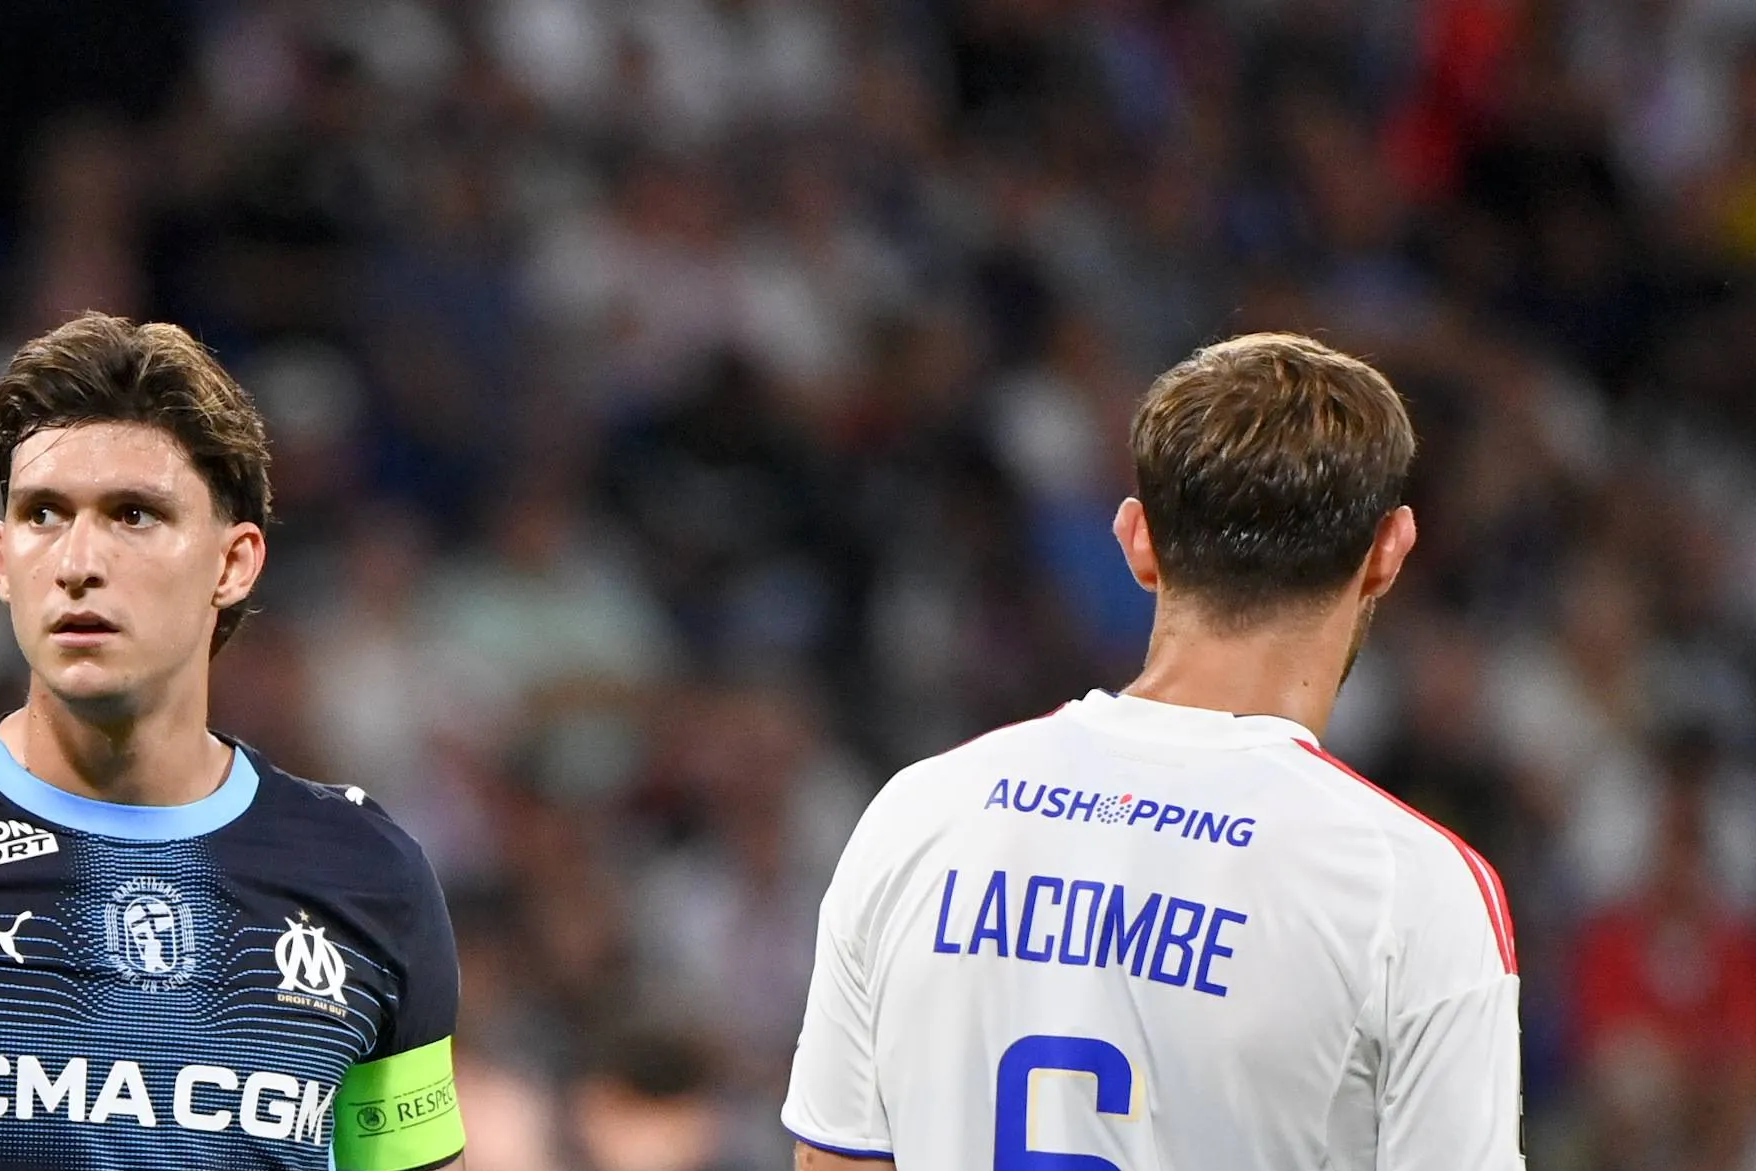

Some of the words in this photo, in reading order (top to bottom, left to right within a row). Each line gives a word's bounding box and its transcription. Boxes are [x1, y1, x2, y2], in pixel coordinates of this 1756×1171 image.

[934, 869, 1248, 997] LACOMBE
[277, 993, 312, 1006] DROIT
[313, 1001, 328, 1011] AU
[329, 1005, 348, 1018] BUT
[173, 1064, 336, 1146] CGM
[397, 1080, 454, 1122] RESPEC
